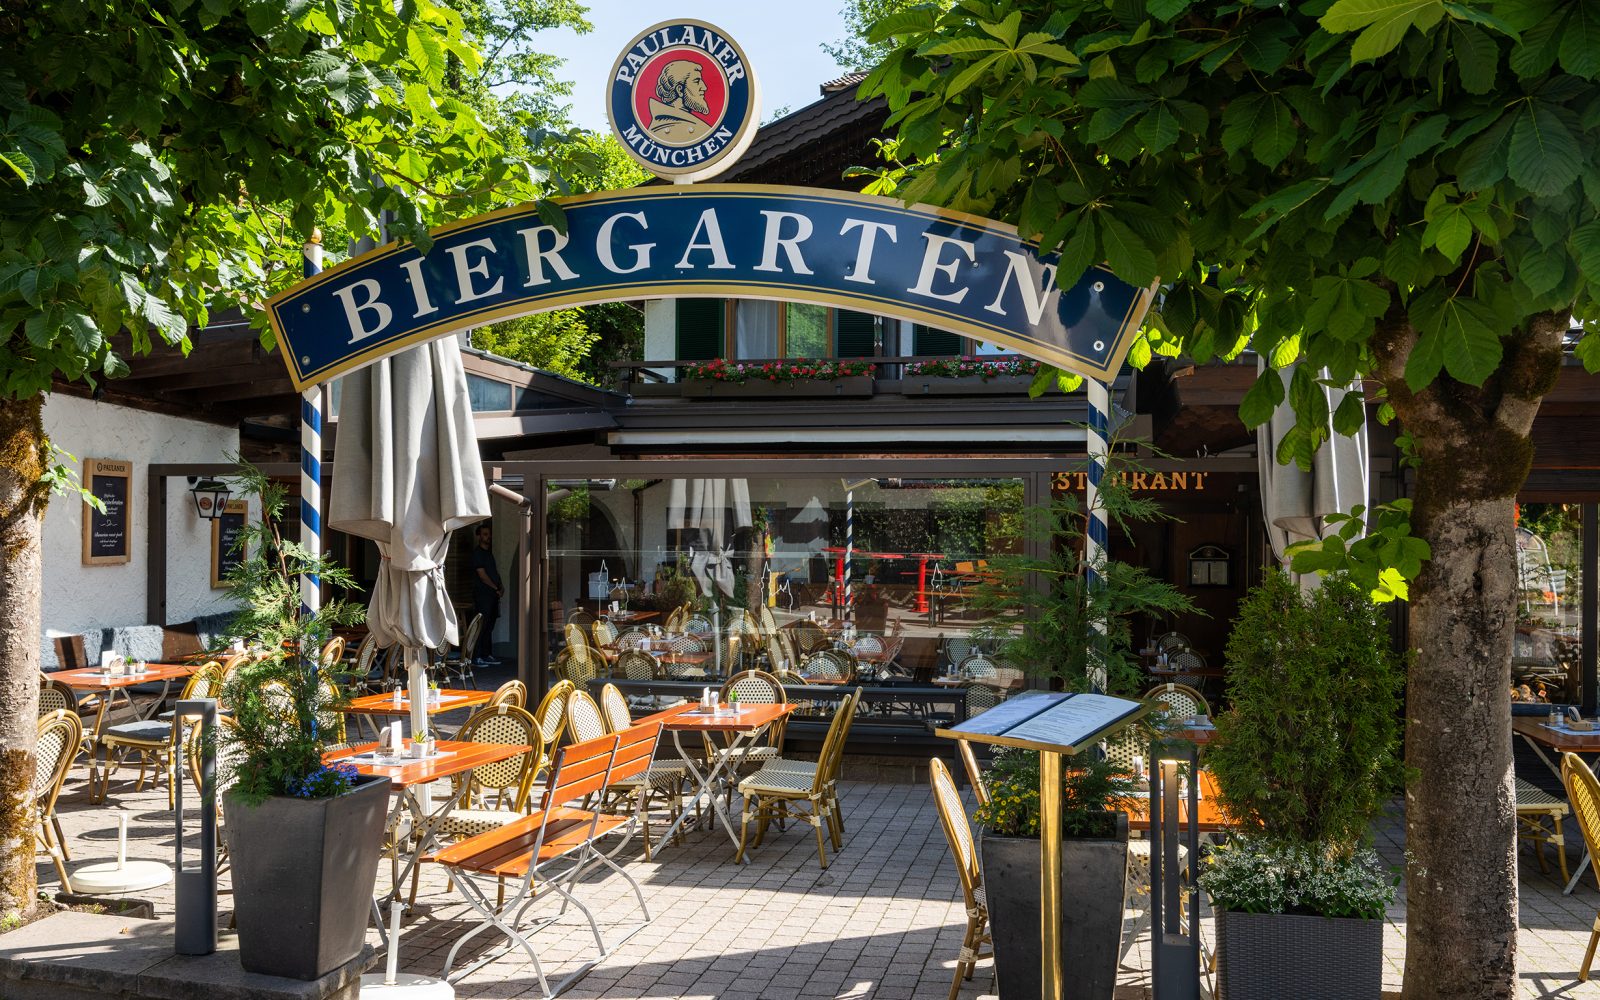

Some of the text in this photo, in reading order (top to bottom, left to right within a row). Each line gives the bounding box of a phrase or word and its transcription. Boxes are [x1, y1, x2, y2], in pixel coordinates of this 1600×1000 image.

[616, 26, 745, 87] PAULANER
[622, 124, 733, 165] MÜNCHEN
[332, 207, 1059, 345] BIERGARTEN
